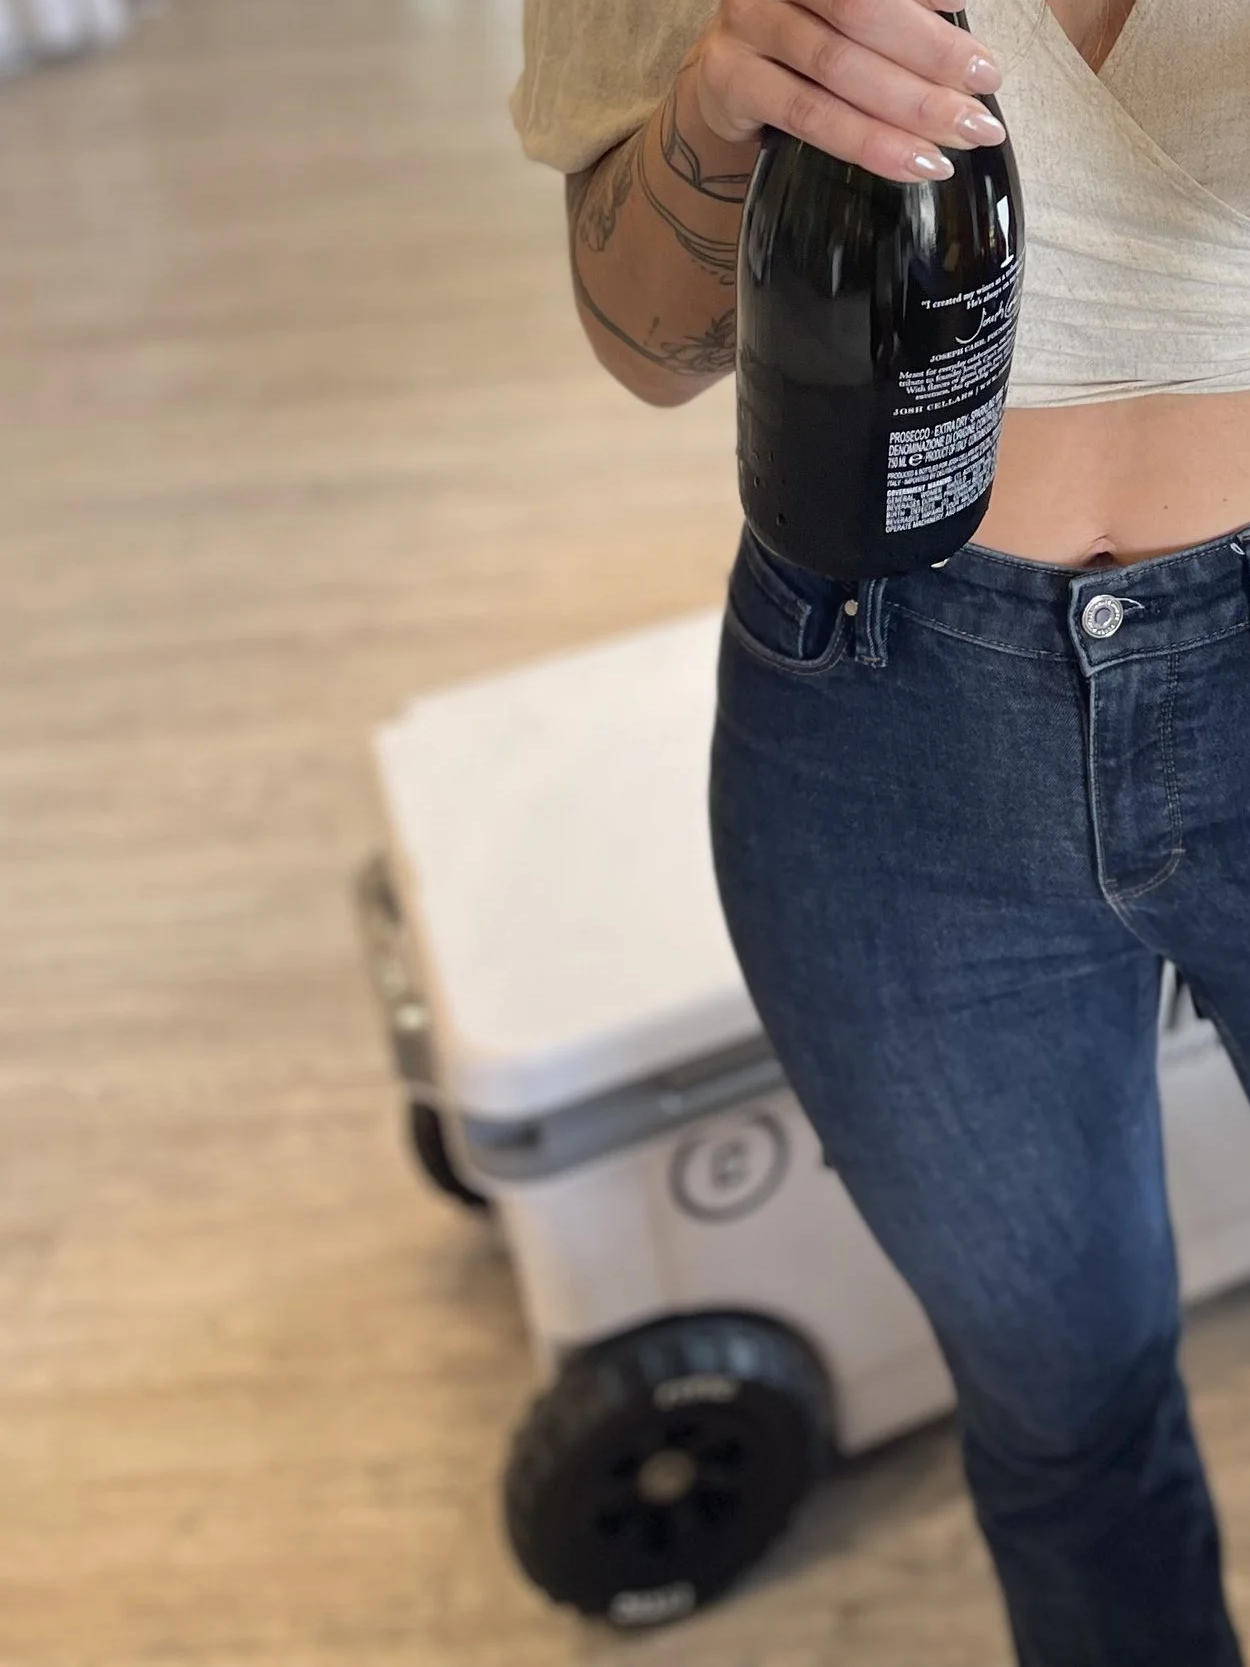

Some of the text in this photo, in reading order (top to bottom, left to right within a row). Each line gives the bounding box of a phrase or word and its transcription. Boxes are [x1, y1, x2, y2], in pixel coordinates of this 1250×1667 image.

[932, 293, 962, 308] created
[963, 291, 975, 301] my
[976, 282, 995, 295] wines
[930, 347, 964, 363] JOSEPH
[899, 370, 924, 380] Meant
[926, 368, 937, 377] for
[938, 360, 966, 373] everyday
[899, 379, 925, 387] tribute
[906, 386, 926, 395] With
[927, 381, 951, 391] flavors
[951, 375, 961, 386] of
[951, 384, 964, 392] this
[893, 389, 974, 416] JOSH CELLARS
[889, 427, 931, 444] PROSECCO
[934, 420, 956, 437] EXTRA
[956, 414, 969, 430] DRY
[888, 437, 945, 457] DENOMINAZIONE
[945, 434, 953, 445] DI
[888, 456, 899, 469] 750
[899, 455, 908, 467] ML
[887, 484, 926, 497] GOVERNMENT
[886, 523, 912, 533] OPERATE
